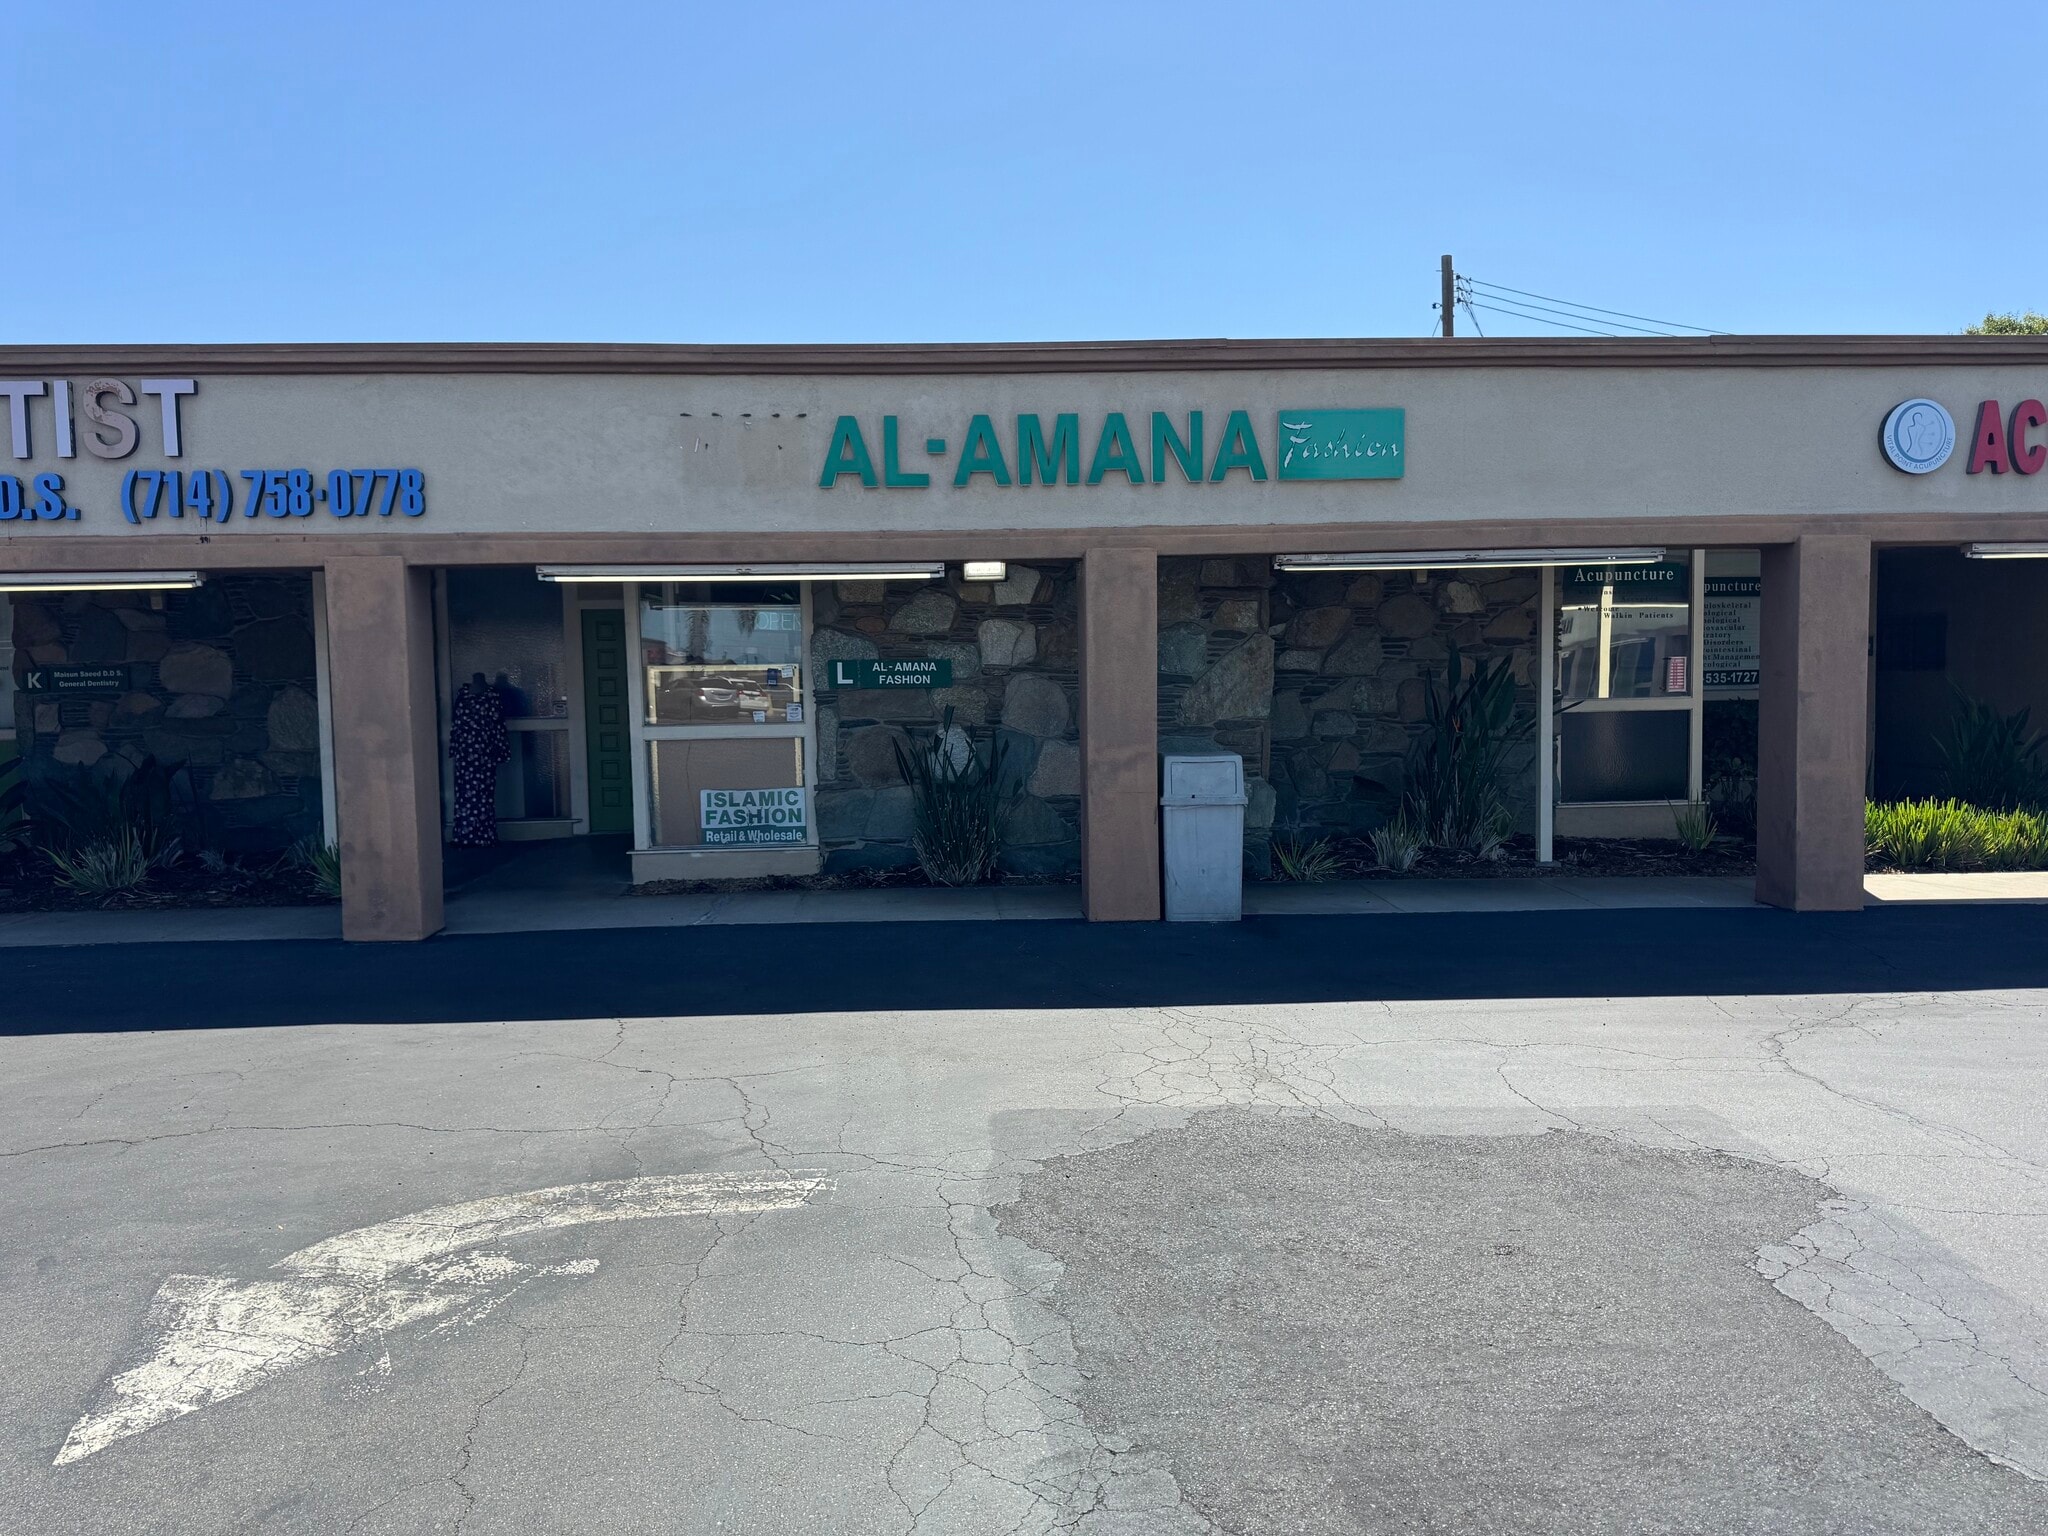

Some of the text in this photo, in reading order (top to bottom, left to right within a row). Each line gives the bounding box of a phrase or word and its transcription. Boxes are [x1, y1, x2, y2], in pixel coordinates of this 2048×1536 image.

[1966, 399, 2047, 475] AC
[818, 410, 1400, 490] AL-AMANA Fashion
[1887, 434, 1953, 469] VITAL POINT ACUPUNCTURE
[120, 469, 233, 524] (714)
[1574, 568, 1675, 583] Acupuncture
[754, 612, 802, 631] OPEN
[836, 661, 854, 684] L
[872, 662, 937, 672] AL-AMANA
[27, 672, 43, 689] K
[87, 679, 120, 688] Dentistry
[879, 675, 931, 684] FASHION
[706, 790, 799, 807] ISLAMIC
[705, 808, 802, 825] FASHION
[706, 829, 803, 842] Retail & Wholesale
